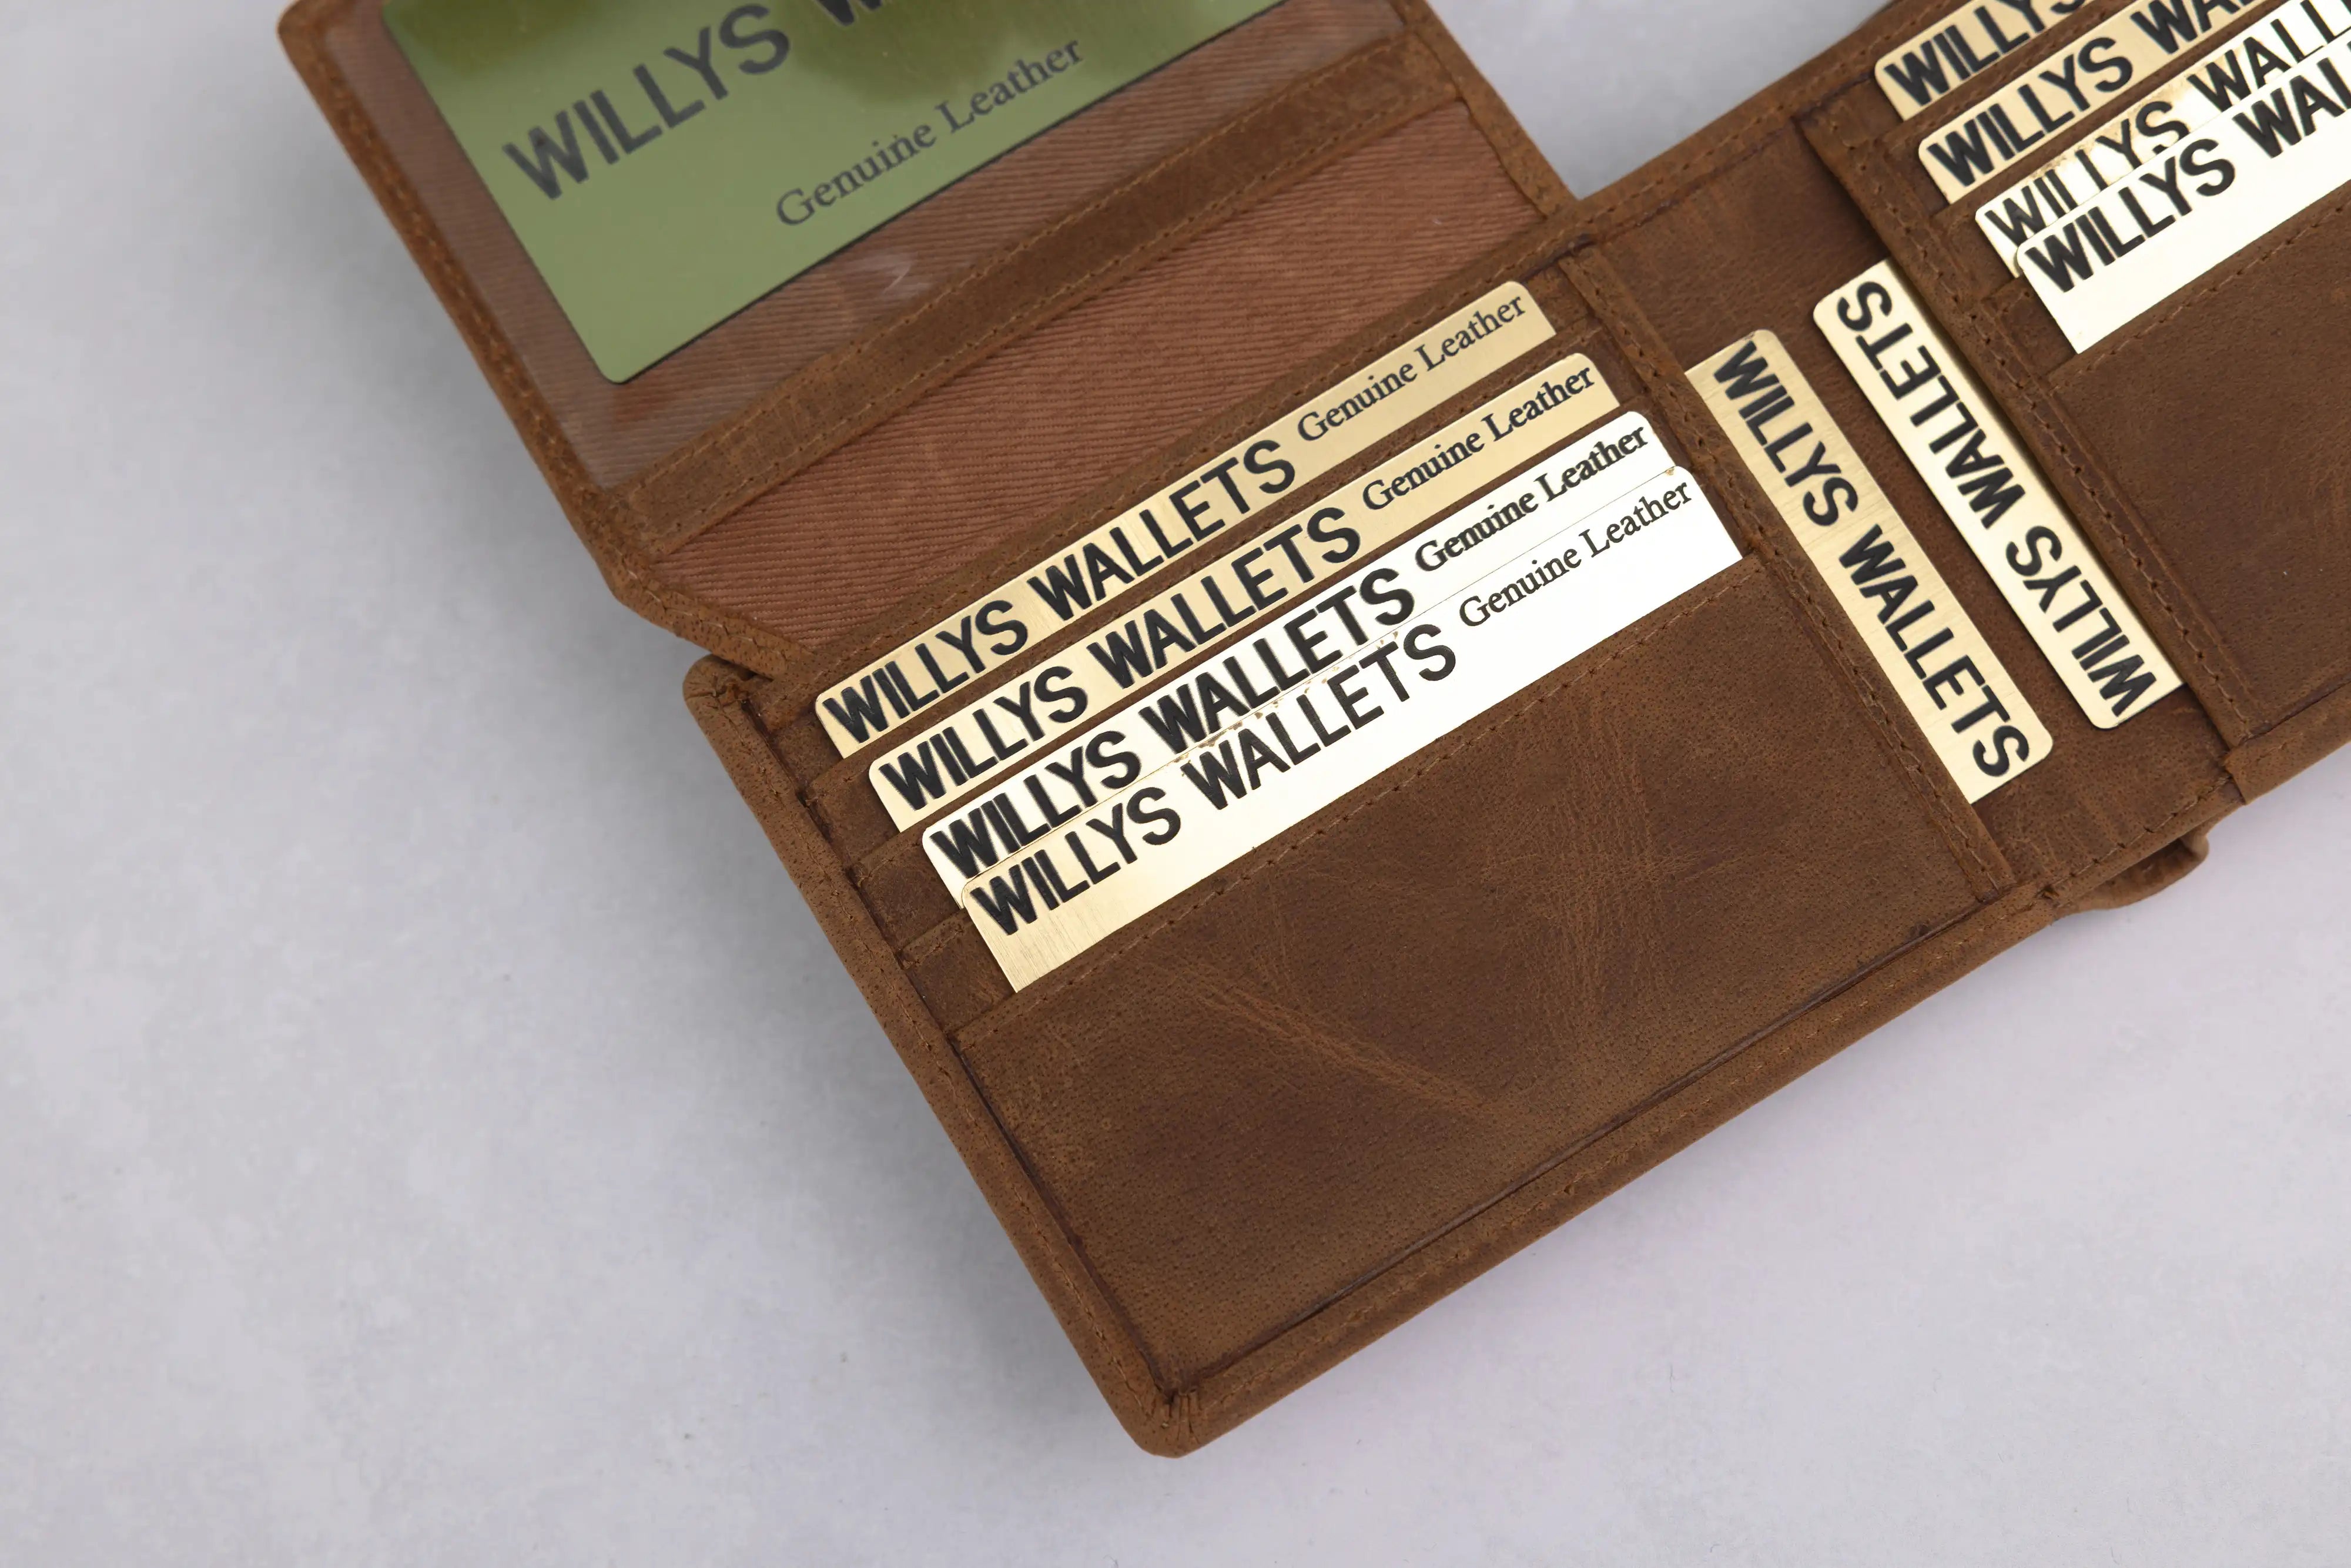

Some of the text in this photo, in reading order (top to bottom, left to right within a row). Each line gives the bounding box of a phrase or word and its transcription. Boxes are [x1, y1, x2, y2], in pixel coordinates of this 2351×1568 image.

[502, 3, 790, 200] WILLYS
[776, 40, 1084, 226] Genuine Leather
[1884, 0, 2085, 106] WILLY
[1928, 0, 2255, 187] WILLYS WA
[2025, 41, 2351, 293] WILLYS WAL
[2186, 0, 2351, 112] WALL
[822, 293, 1526, 743] WILLYS WALLETS Genuine Leather
[879, 364, 1595, 810] WILLYS WALLETS Genuine Leather
[929, 427, 1648, 877] WILLYS WALLETS Genuine Leather
[1714, 340, 2029, 777] WILLYS WALLETS
[1837, 282, 2157, 717] WILLYS WALLETS
[971, 481, 1692, 934] WILLYS WALLETS Genuine Leather
